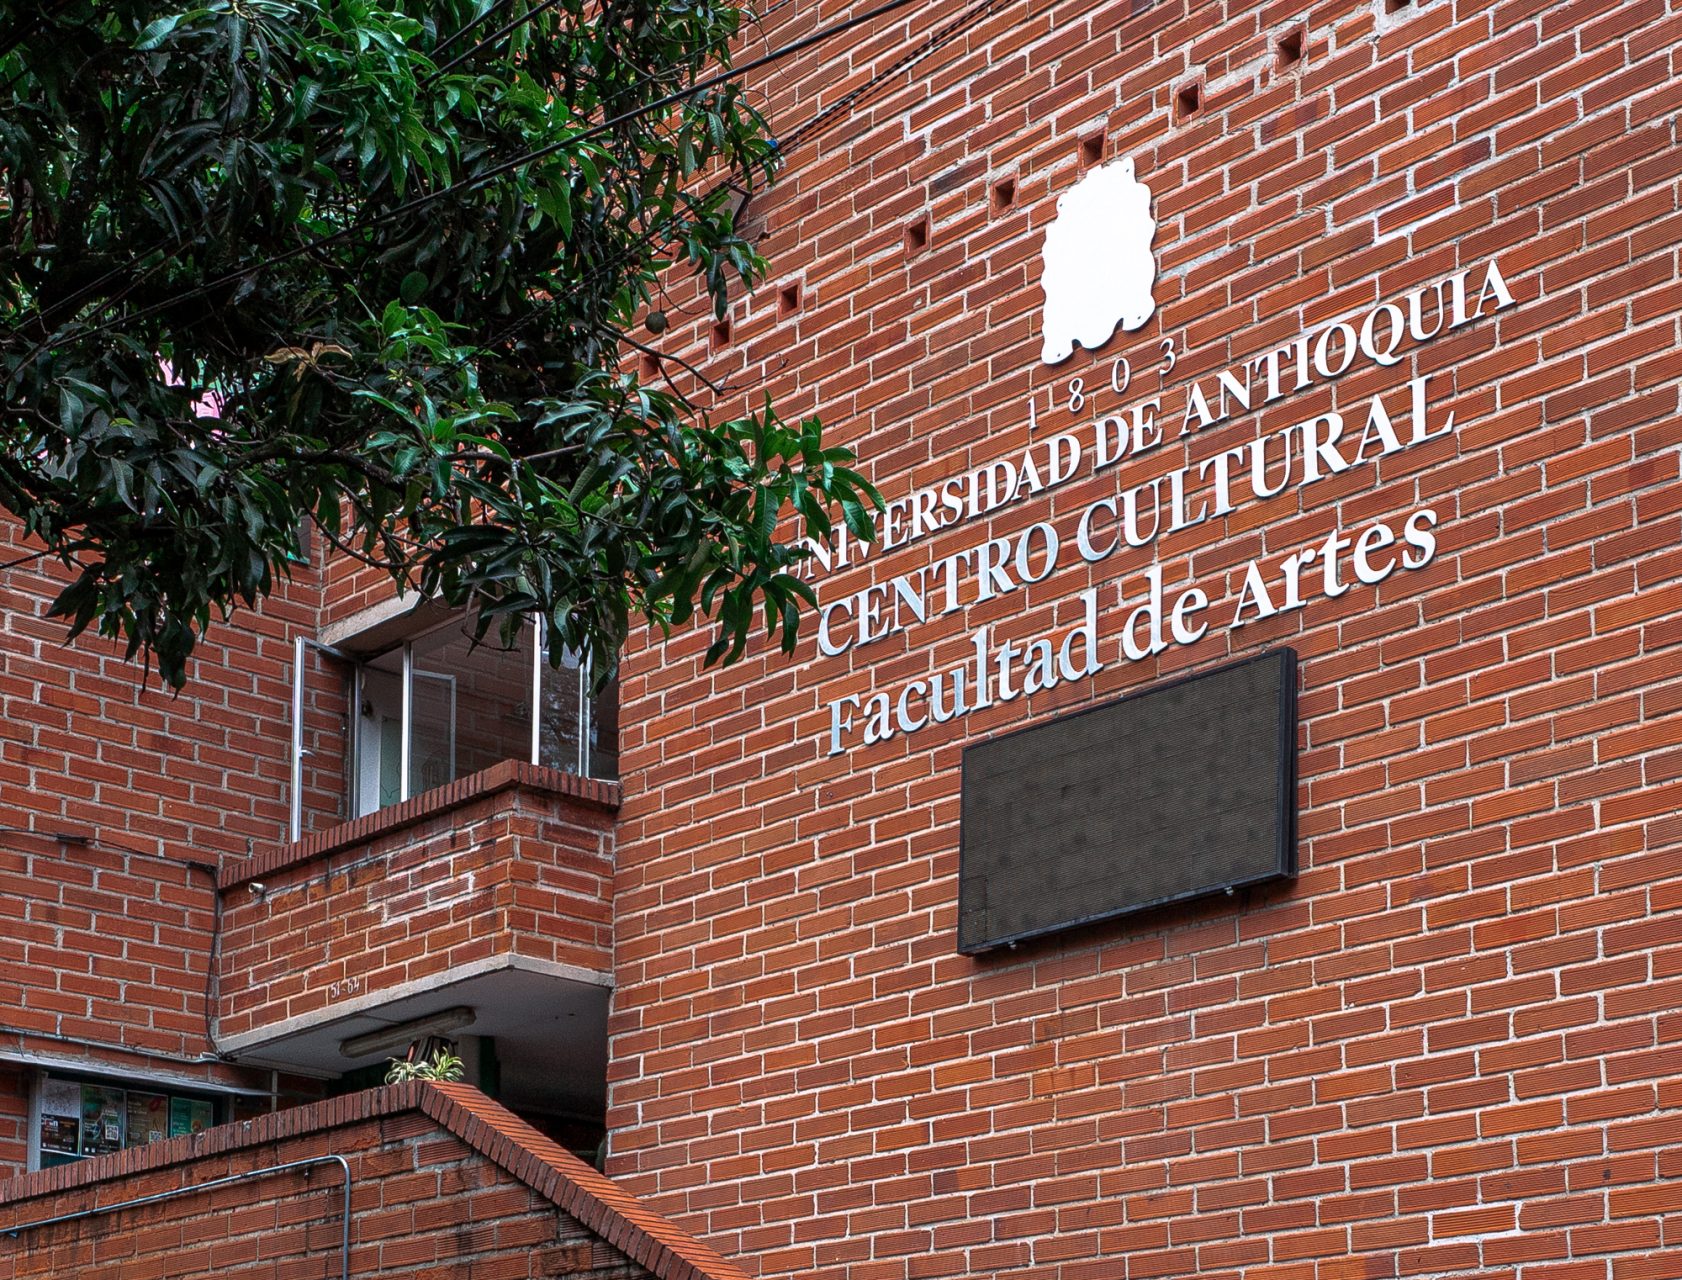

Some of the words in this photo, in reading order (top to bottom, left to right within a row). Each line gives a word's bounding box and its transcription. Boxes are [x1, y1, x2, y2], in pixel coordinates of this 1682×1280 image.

[1094, 398, 1162, 470] DE
[1179, 260, 1516, 437] ANTIOQUIA
[818, 521, 1058, 657] CENTRO
[1076, 374, 1455, 563] CULTURAL
[827, 588, 1104, 757] Facultad
[1122, 565, 1208, 661] de
[1229, 509, 1438, 629] Artes
